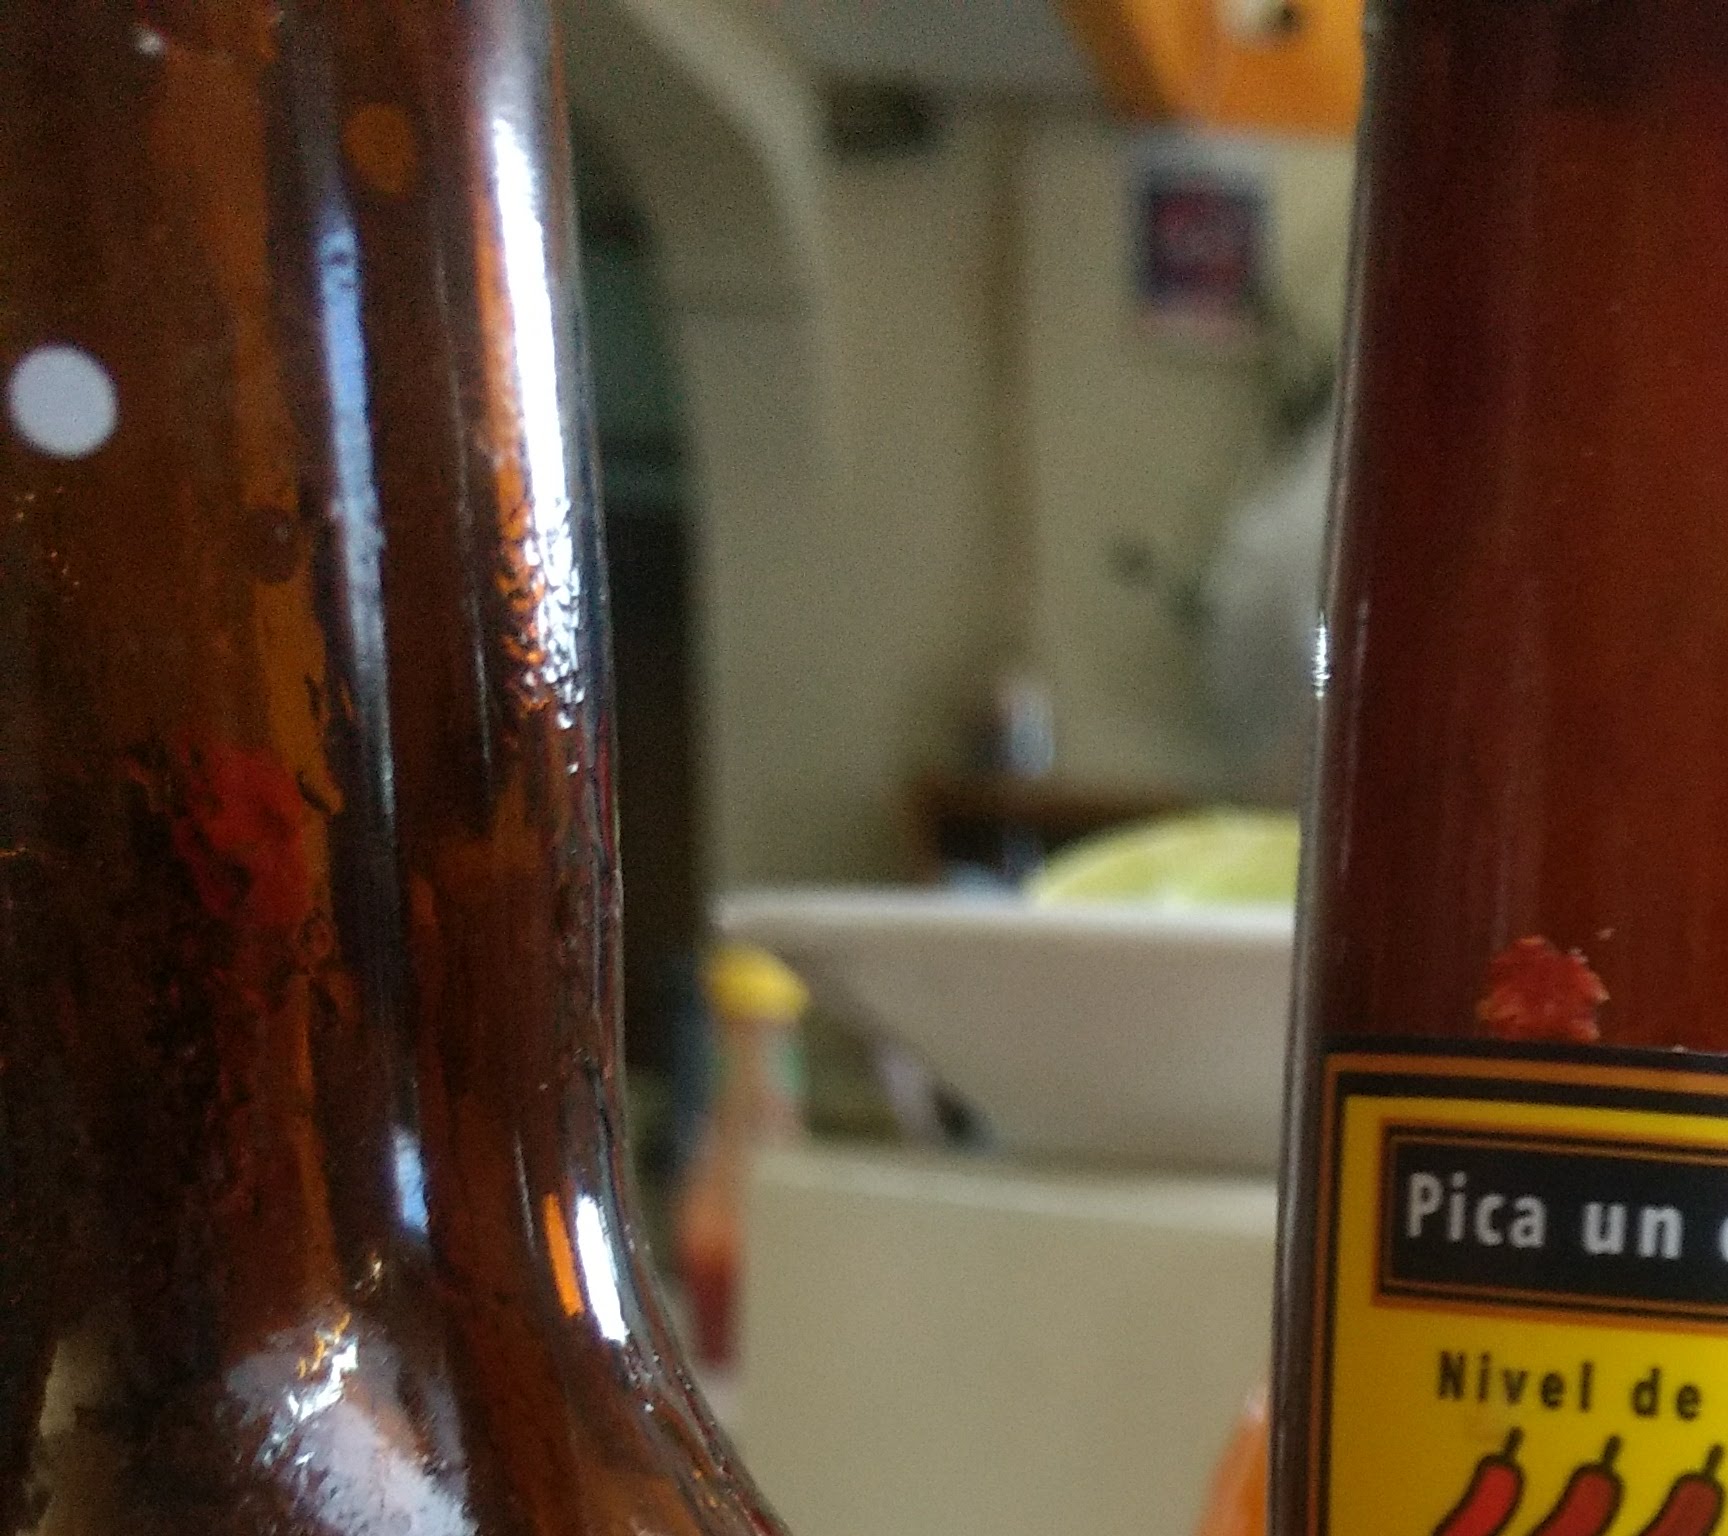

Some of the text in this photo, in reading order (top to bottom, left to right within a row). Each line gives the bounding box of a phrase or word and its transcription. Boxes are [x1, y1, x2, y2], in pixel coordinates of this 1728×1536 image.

[1405, 1172, 1547, 1250] Pica
[1582, 1200, 1684, 1259] un
[1437, 1349, 1593, 1412] Nivel
[1631, 1367, 1702, 1420] de
